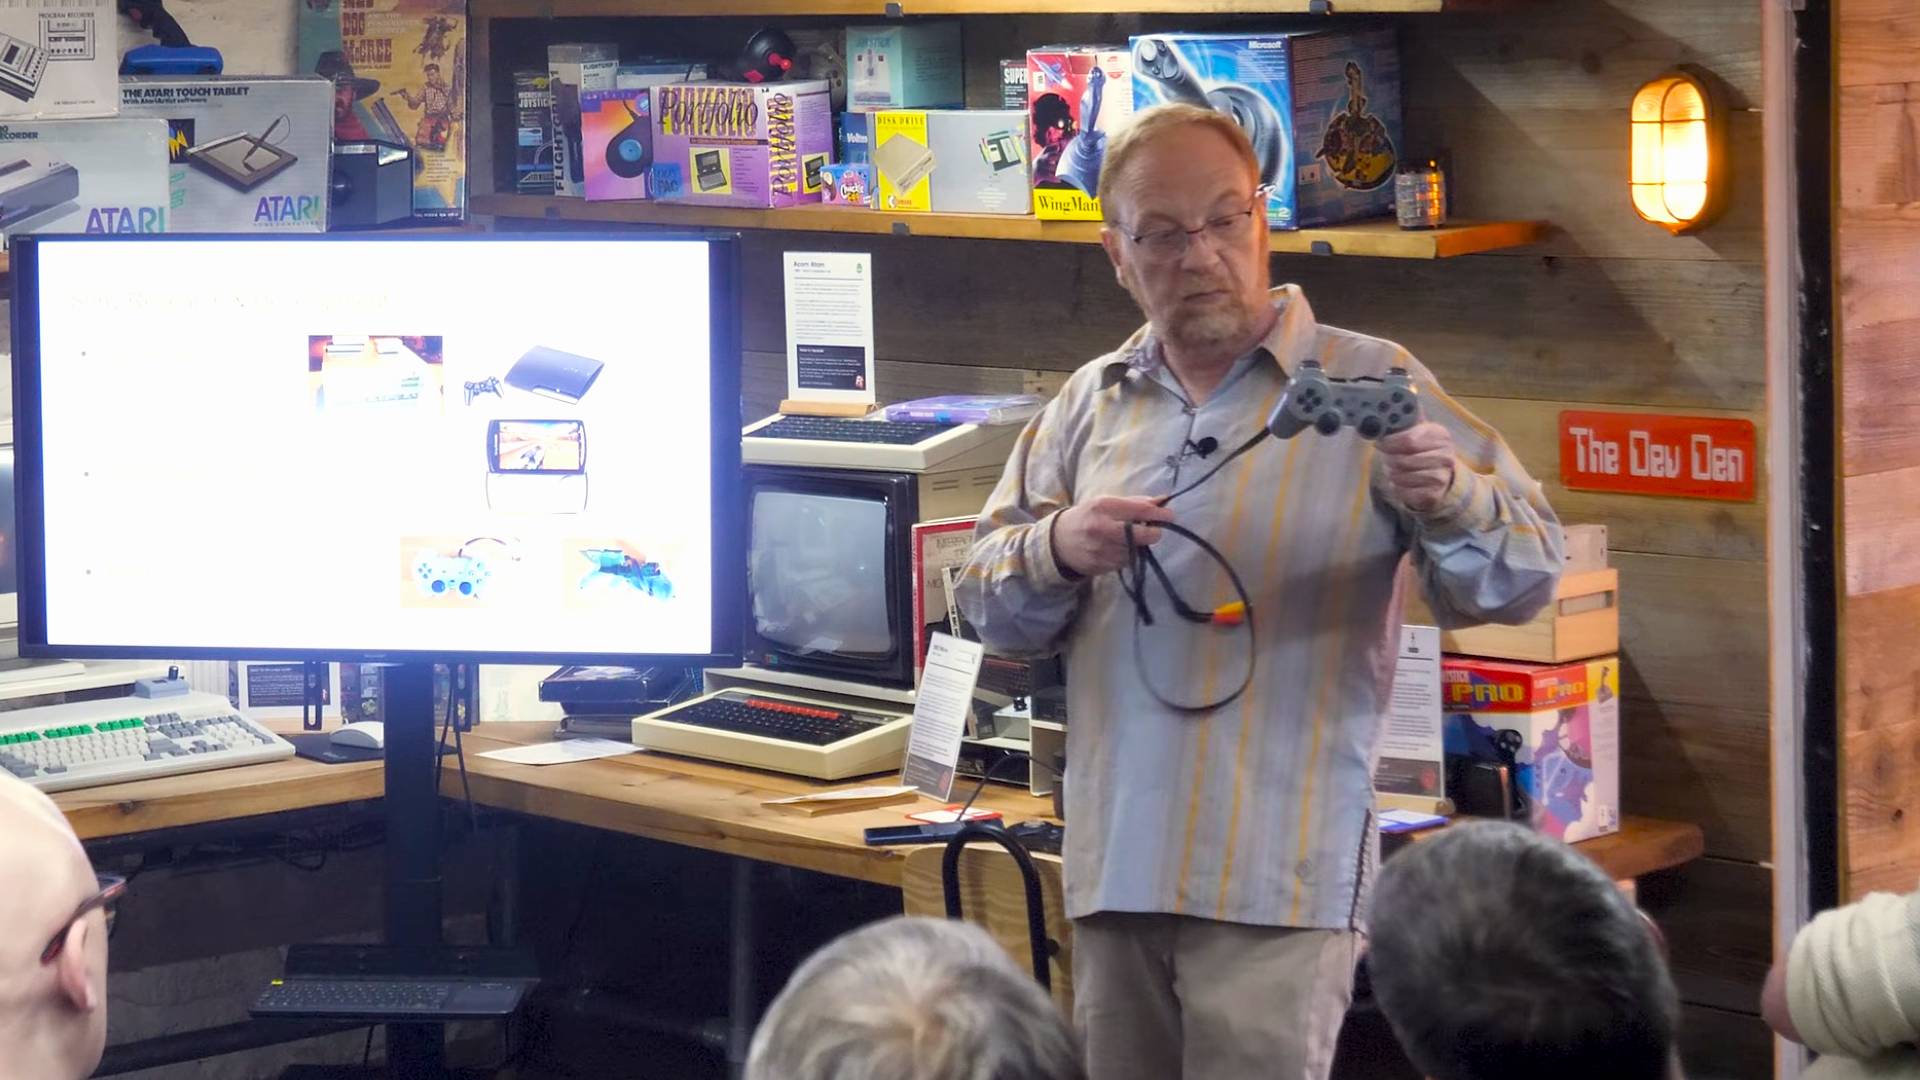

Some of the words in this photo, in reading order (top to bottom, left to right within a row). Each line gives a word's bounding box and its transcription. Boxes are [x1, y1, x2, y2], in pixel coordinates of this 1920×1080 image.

[343, 12, 366, 36] DOG
[1248, 40, 1282, 49] Microsoft
[122, 89, 143, 98] THE
[144, 88, 174, 98] ATARI
[175, 87, 211, 97] TOUCH
[212, 86, 250, 96] TABLET
[657, 90, 759, 133] Portfolio
[877, 116, 897, 125] DISK
[899, 116, 925, 125] DRIVE
[769, 93, 796, 197] Portfolio
[254, 194, 321, 222] ATARI
[1038, 195, 1099, 211] WingMan
[86, 207, 167, 234] ATARI
[1569, 427, 1619, 475] The
[1629, 430, 1681, 478] Dev
[1691, 433, 1744, 482] Den
[1451, 683, 1524, 701] PRO
[1547, 681, 1585, 699] PRO
